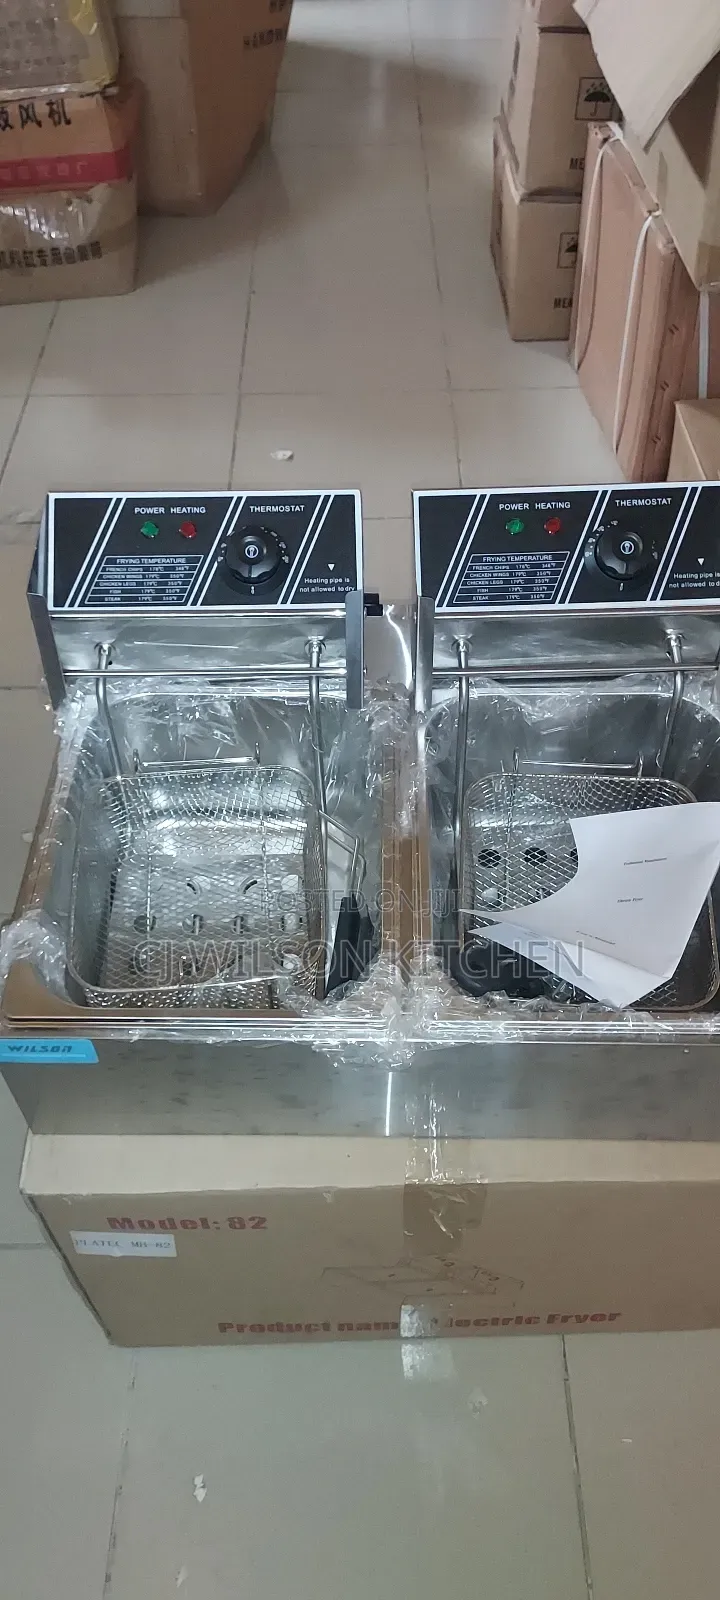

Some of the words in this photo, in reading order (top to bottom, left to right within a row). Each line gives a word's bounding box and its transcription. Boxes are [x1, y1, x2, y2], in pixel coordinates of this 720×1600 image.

[499, 503, 529, 511] POWER
[535, 501, 571, 509] HEATING
[615, 498, 672, 507] THERMOSTAT
[170, 506, 206, 514] HEATING
[249, 504, 305, 513] THERMOSTAT
[507, 554, 553, 562] TEMPERATURE
[218, 1321, 332, 1334] Product
[337, 1321, 399, 1332] nam
[444, 1314, 541, 1328] lectric
[546, 1312, 622, 1325] Fryer
